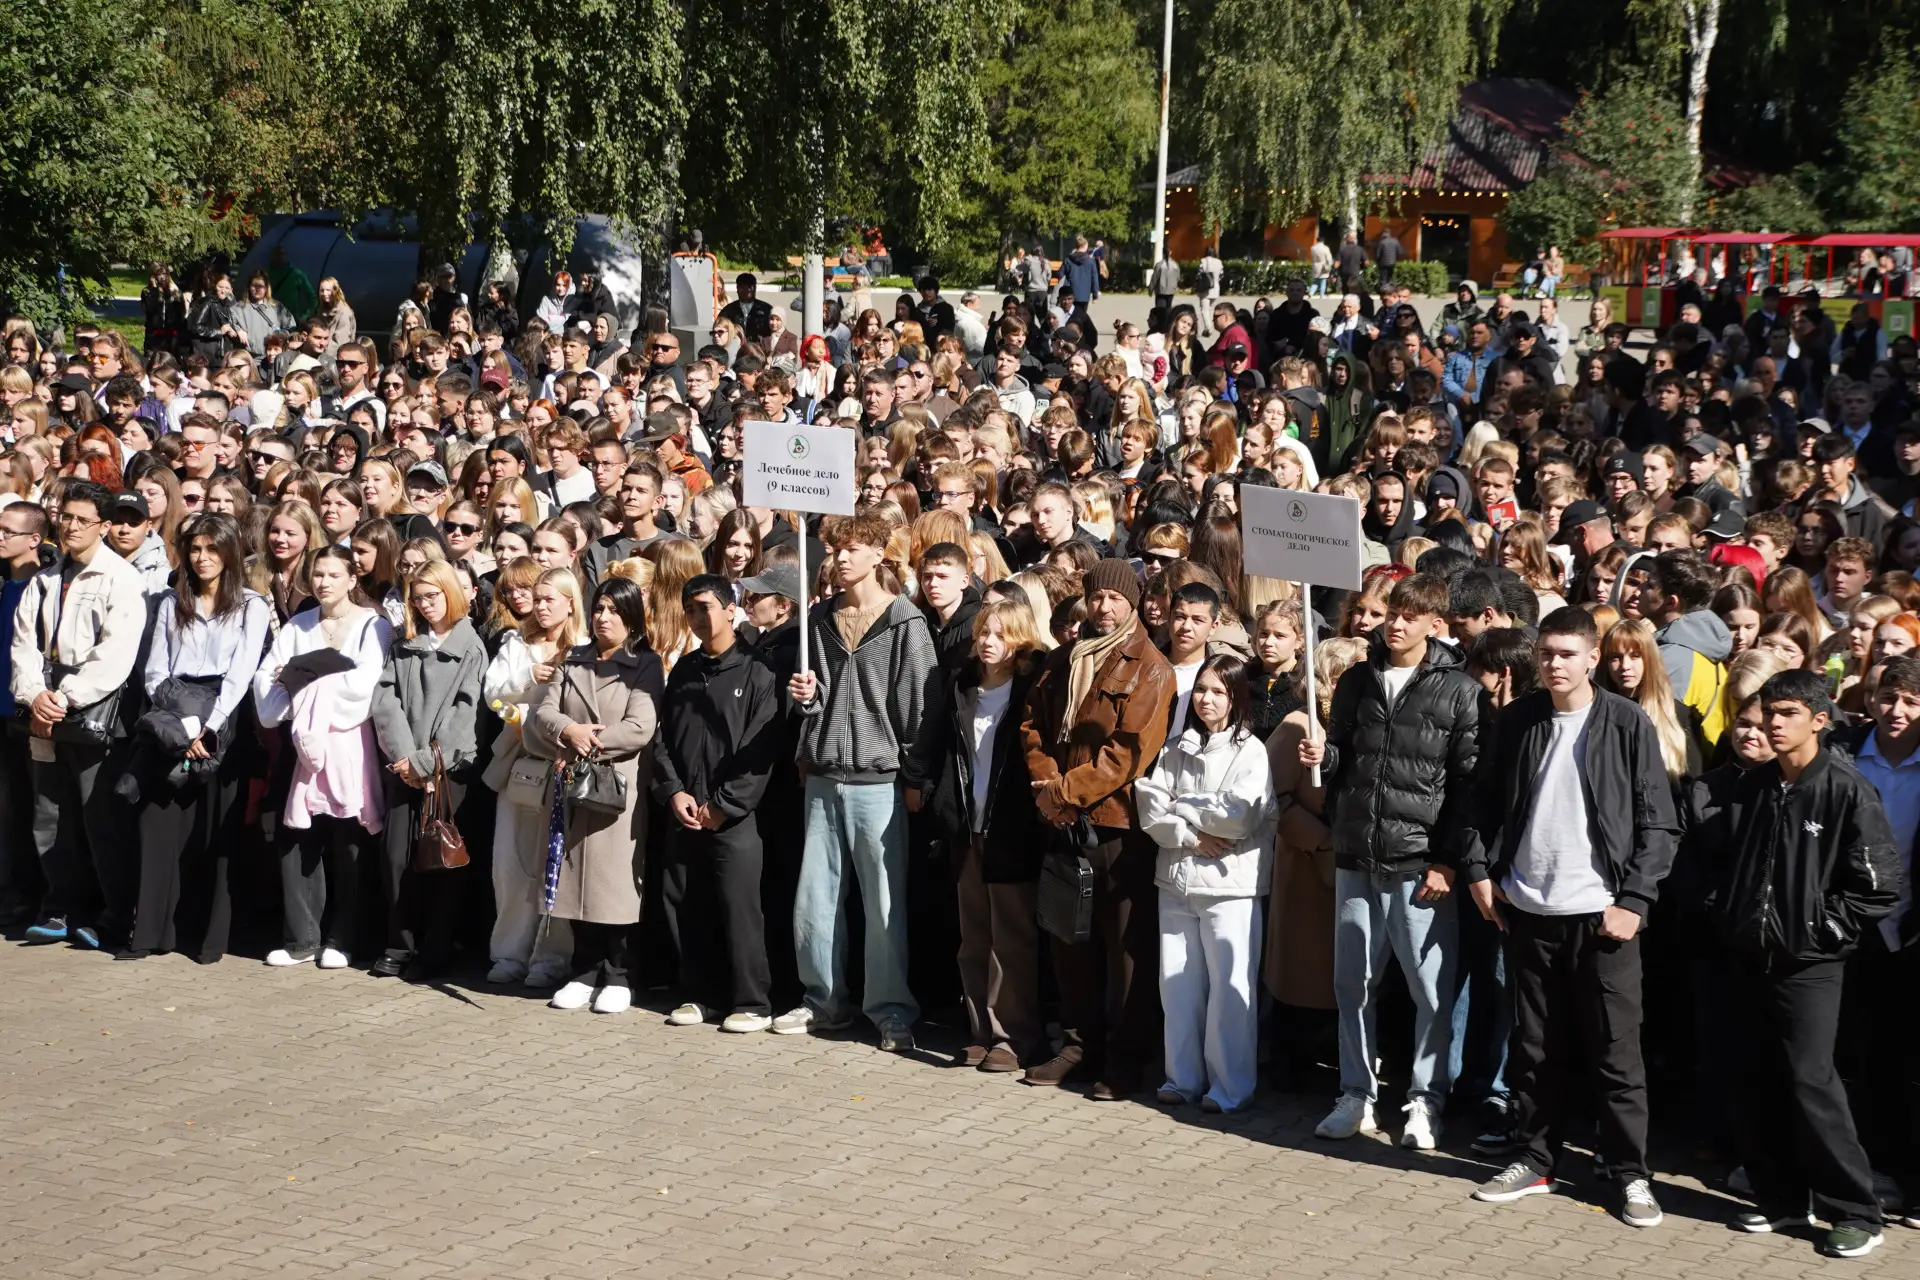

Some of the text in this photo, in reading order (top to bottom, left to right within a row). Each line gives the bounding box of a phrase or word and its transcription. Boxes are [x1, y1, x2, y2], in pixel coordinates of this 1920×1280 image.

[757, 462, 839, 480] Лечебное дело
[767, 480, 830, 497] (9 классов)
[1251, 526, 1350, 547] СТОМАТОЛОГИЧЕСКОЕ
[1286, 541, 1310, 552] ДЕЛО
